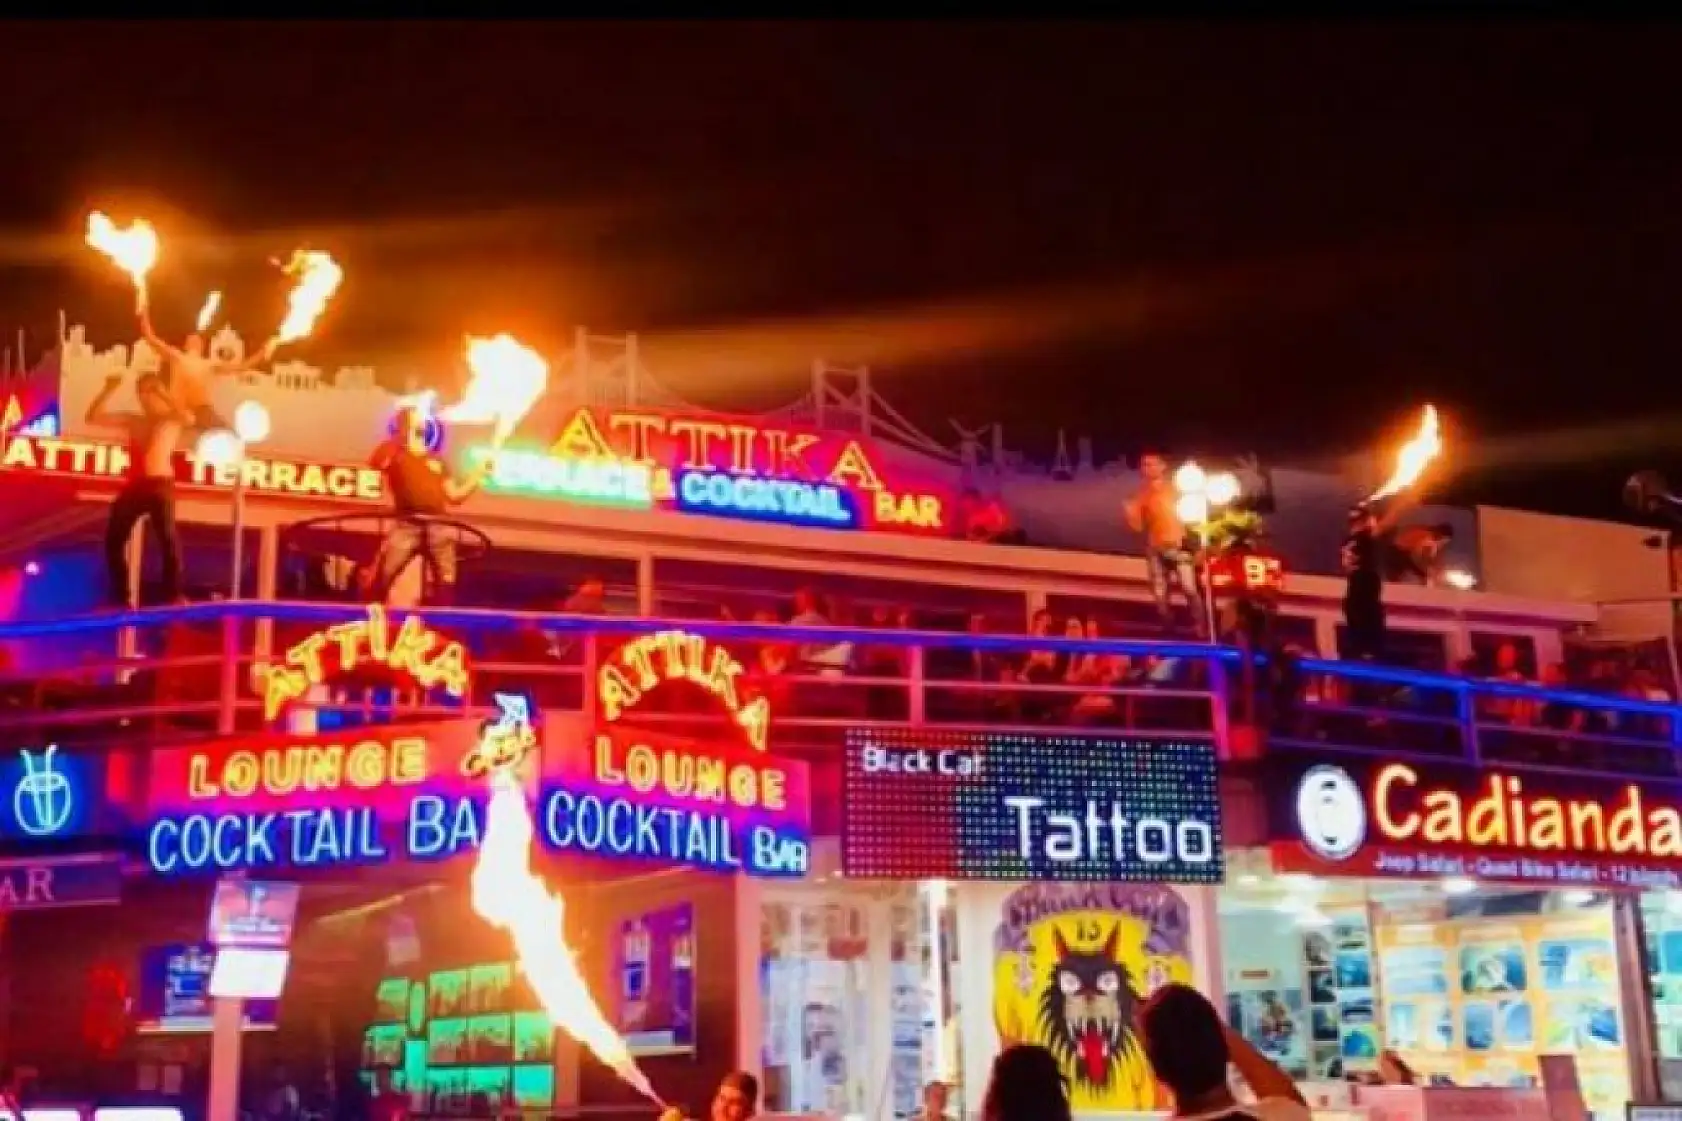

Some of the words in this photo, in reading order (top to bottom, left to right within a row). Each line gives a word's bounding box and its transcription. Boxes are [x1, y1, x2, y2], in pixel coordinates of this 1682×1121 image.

[2, 437, 131, 475] ATTIK
[186, 450, 382, 498] TERRACE
[551, 407, 884, 490] ATTIKA
[680, 472, 851, 522] COCKTAIL
[875, 490, 942, 528] BAR
[261, 603, 470, 720] ATTIKA
[599, 630, 770, 752] ATTIKA
[188, 736, 428, 799] LOUNGE
[595, 734, 788, 810] LOUNGE
[862, 746, 932, 773] Black
[939, 749, 984, 776] Cat
[408, 794, 480, 854] BA
[548, 789, 742, 866] COCKTAIL
[1003, 795, 1213, 863] Tattoo
[1372, 763, 1682, 857] Cadianda
[0, 868, 55, 901] AR
